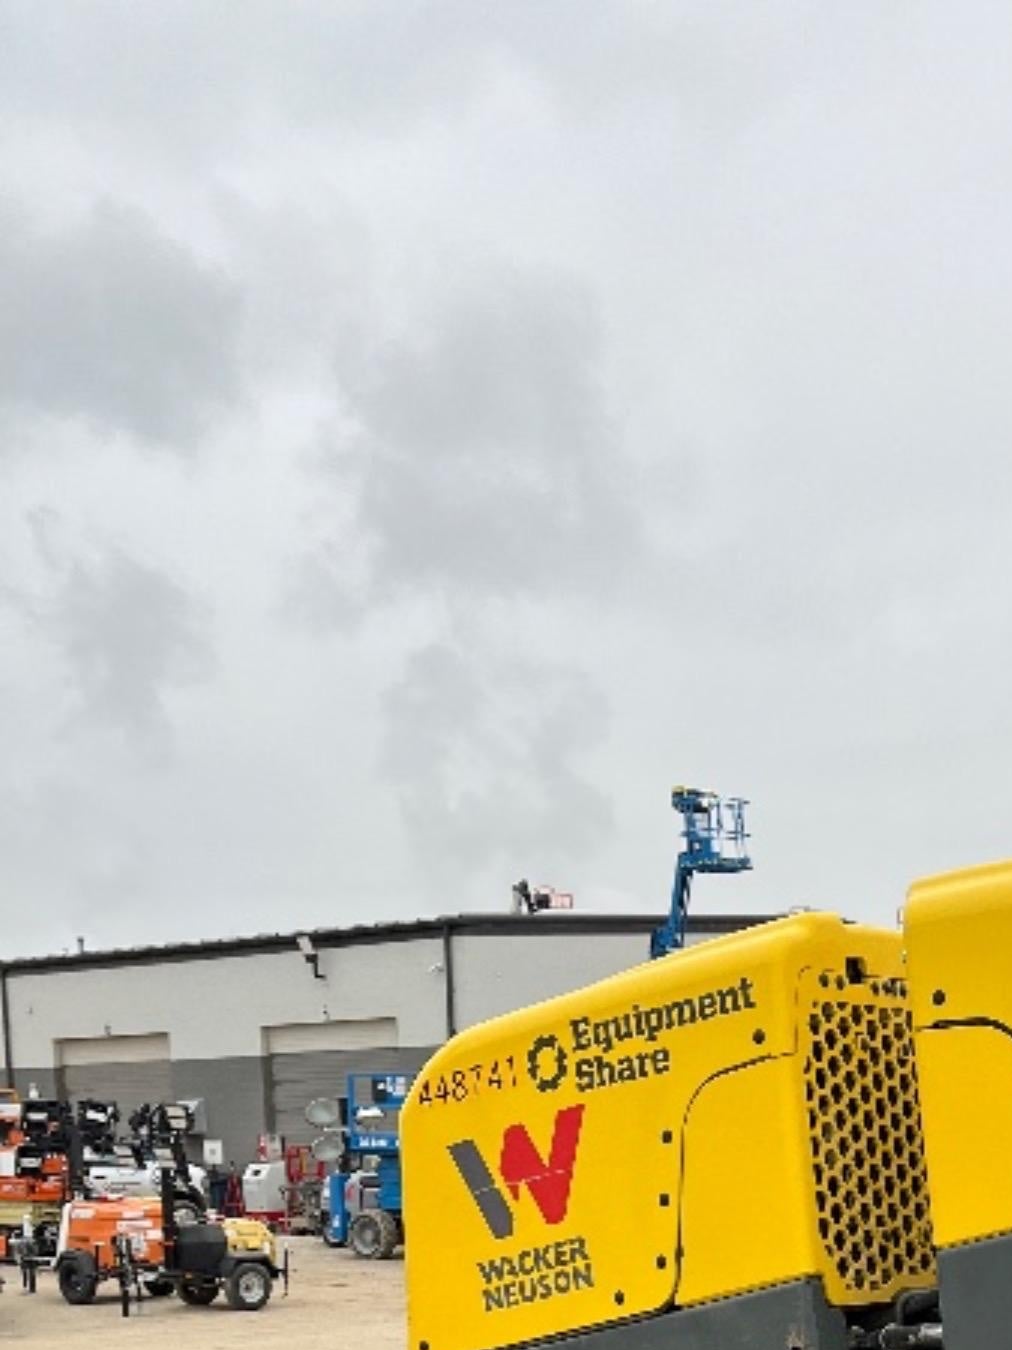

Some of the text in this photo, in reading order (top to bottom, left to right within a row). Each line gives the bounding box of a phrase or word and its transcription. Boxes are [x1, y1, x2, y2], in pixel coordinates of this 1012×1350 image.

[569, 976, 756, 1053] Equipment
[419, 1055, 517, 1107] 448741
[575, 1047, 670, 1092] Share
[476, 1236, 589, 1285] WACKER
[482, 1263, 594, 1312] NEUSON
